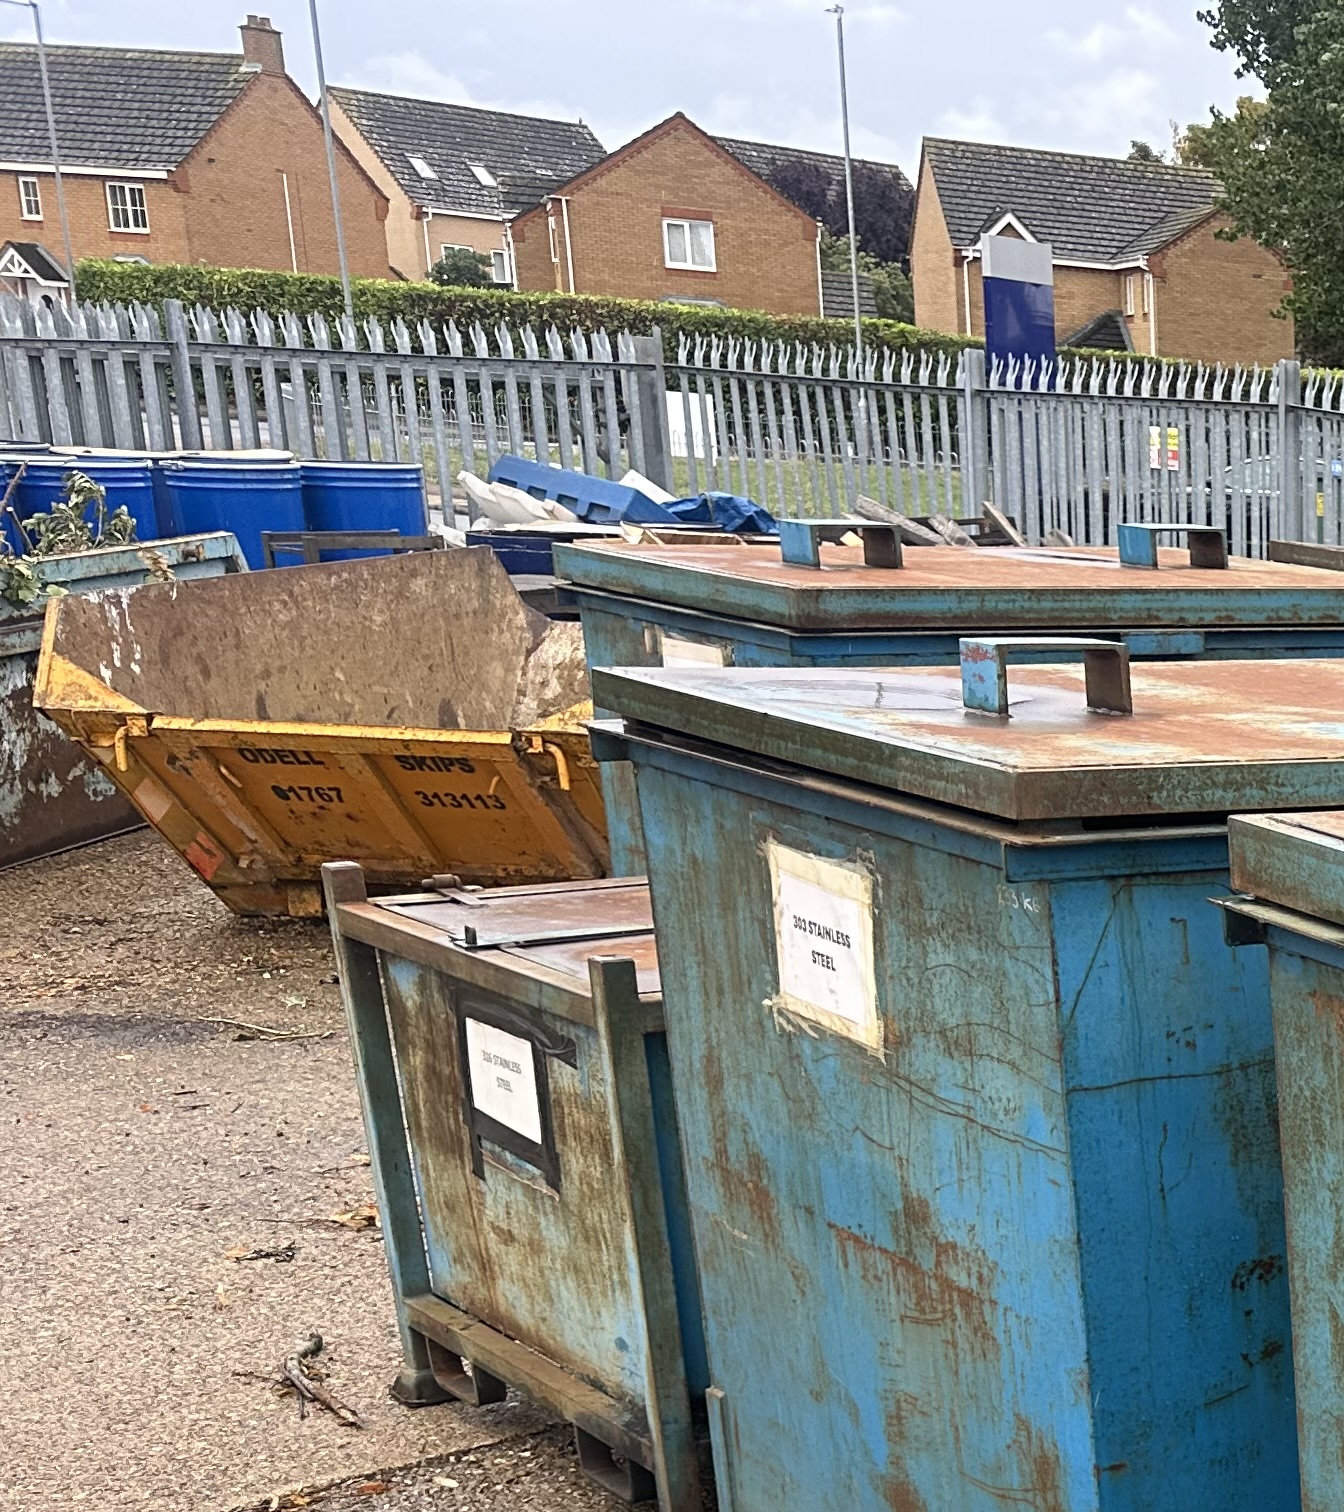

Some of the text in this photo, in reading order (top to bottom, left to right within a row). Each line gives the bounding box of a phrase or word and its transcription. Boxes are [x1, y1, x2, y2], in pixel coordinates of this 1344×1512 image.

[238, 747, 475, 774] ODELL SKIPS
[414, 790, 507, 810] 313113
[793, 914, 851, 949] 303 STAINLESS
[811, 949, 836, 972] STEEL
